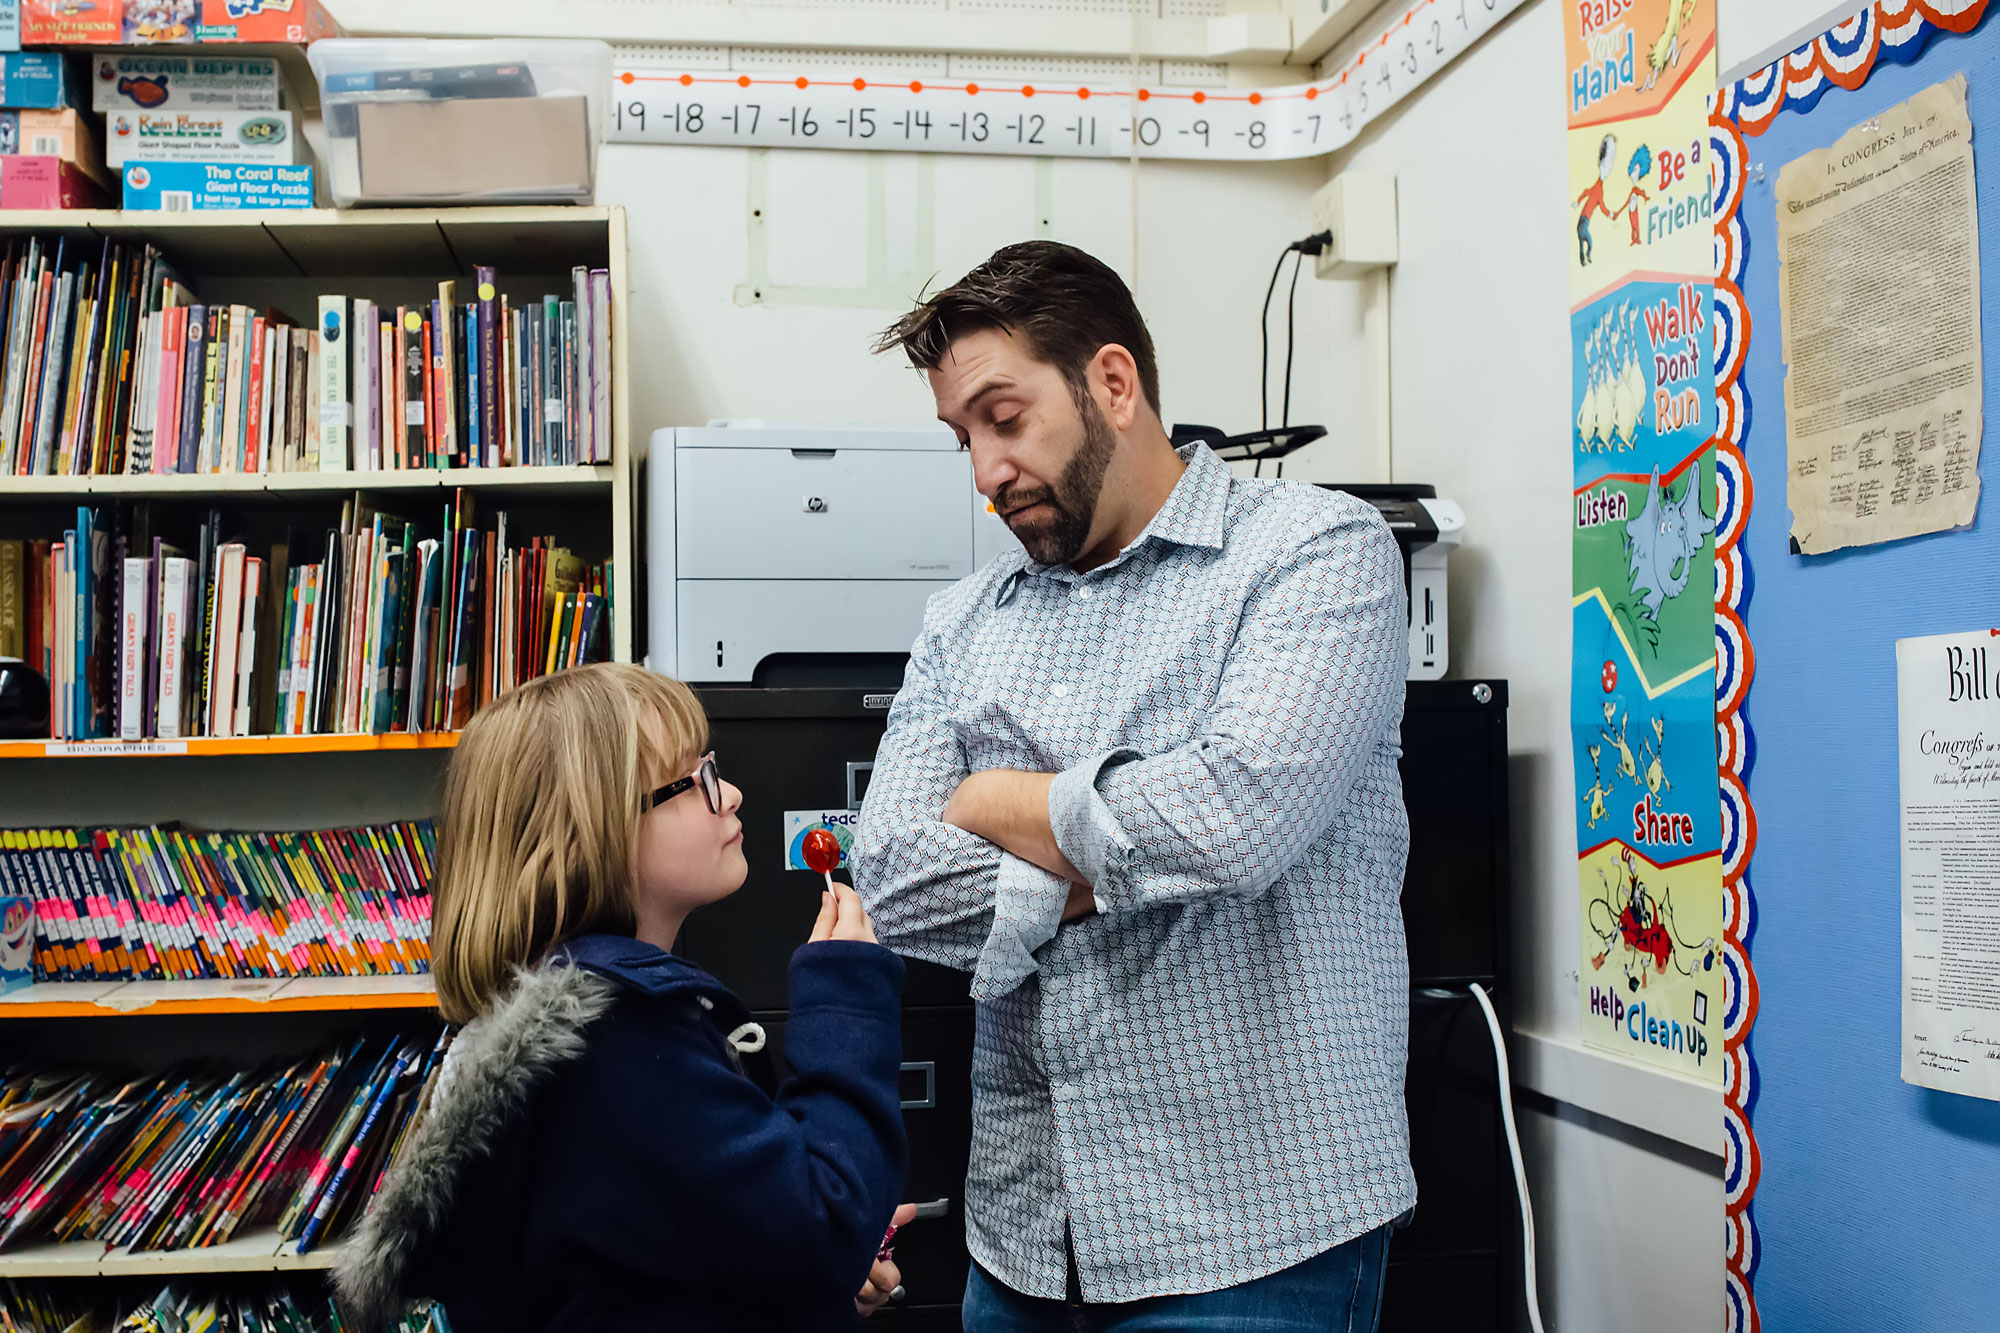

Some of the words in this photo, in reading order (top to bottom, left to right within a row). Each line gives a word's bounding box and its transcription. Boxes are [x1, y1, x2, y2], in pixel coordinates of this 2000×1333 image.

[118, 58, 189, 74] OCEAN
[1587, 23, 1625, 67] Your
[1572, 31, 1634, 112] Hand
[663, 102, 704, 133] -18
[722, 104, 761, 135] -17
[778, 106, 819, 136] -16
[836, 108, 876, 138] -15
[893, 110, 933, 140] -14
[950, 112, 990, 142] -13
[1006, 114, 1046, 144] -12
[1066, 116, 1096, 146] -11
[1178, 120, 1210, 148] -9
[1234, 120, 1266, 149] -8
[1292, 114, 1322, 144] -7
[206, 166, 232, 180] The
[236, 167, 273, 181] Coral
[277, 168, 310, 182] Reef
[206, 181, 238, 193] Giant
[240, 182, 268, 194] Floor
[272, 183, 309, 196] Puzzle
[1658, 150, 1686, 192] Be
[1691, 139, 1701, 164] a
[1647, 174, 1712, 245] Friend
[1644, 284, 1704, 348] Walk
[1656, 337, 1699, 386] Don't
[1655, 389, 1699, 433] Run
[1577, 490, 1628, 526] Listen
[126, 674, 134, 698] TALES
[164, 674, 174, 697] TALES
[1946, 646, 1988, 702] Bill
[1635, 795, 1693, 845] Share
[1590, 986, 1624, 1031] Help
[1626, 1001, 1683, 1053] Clean
